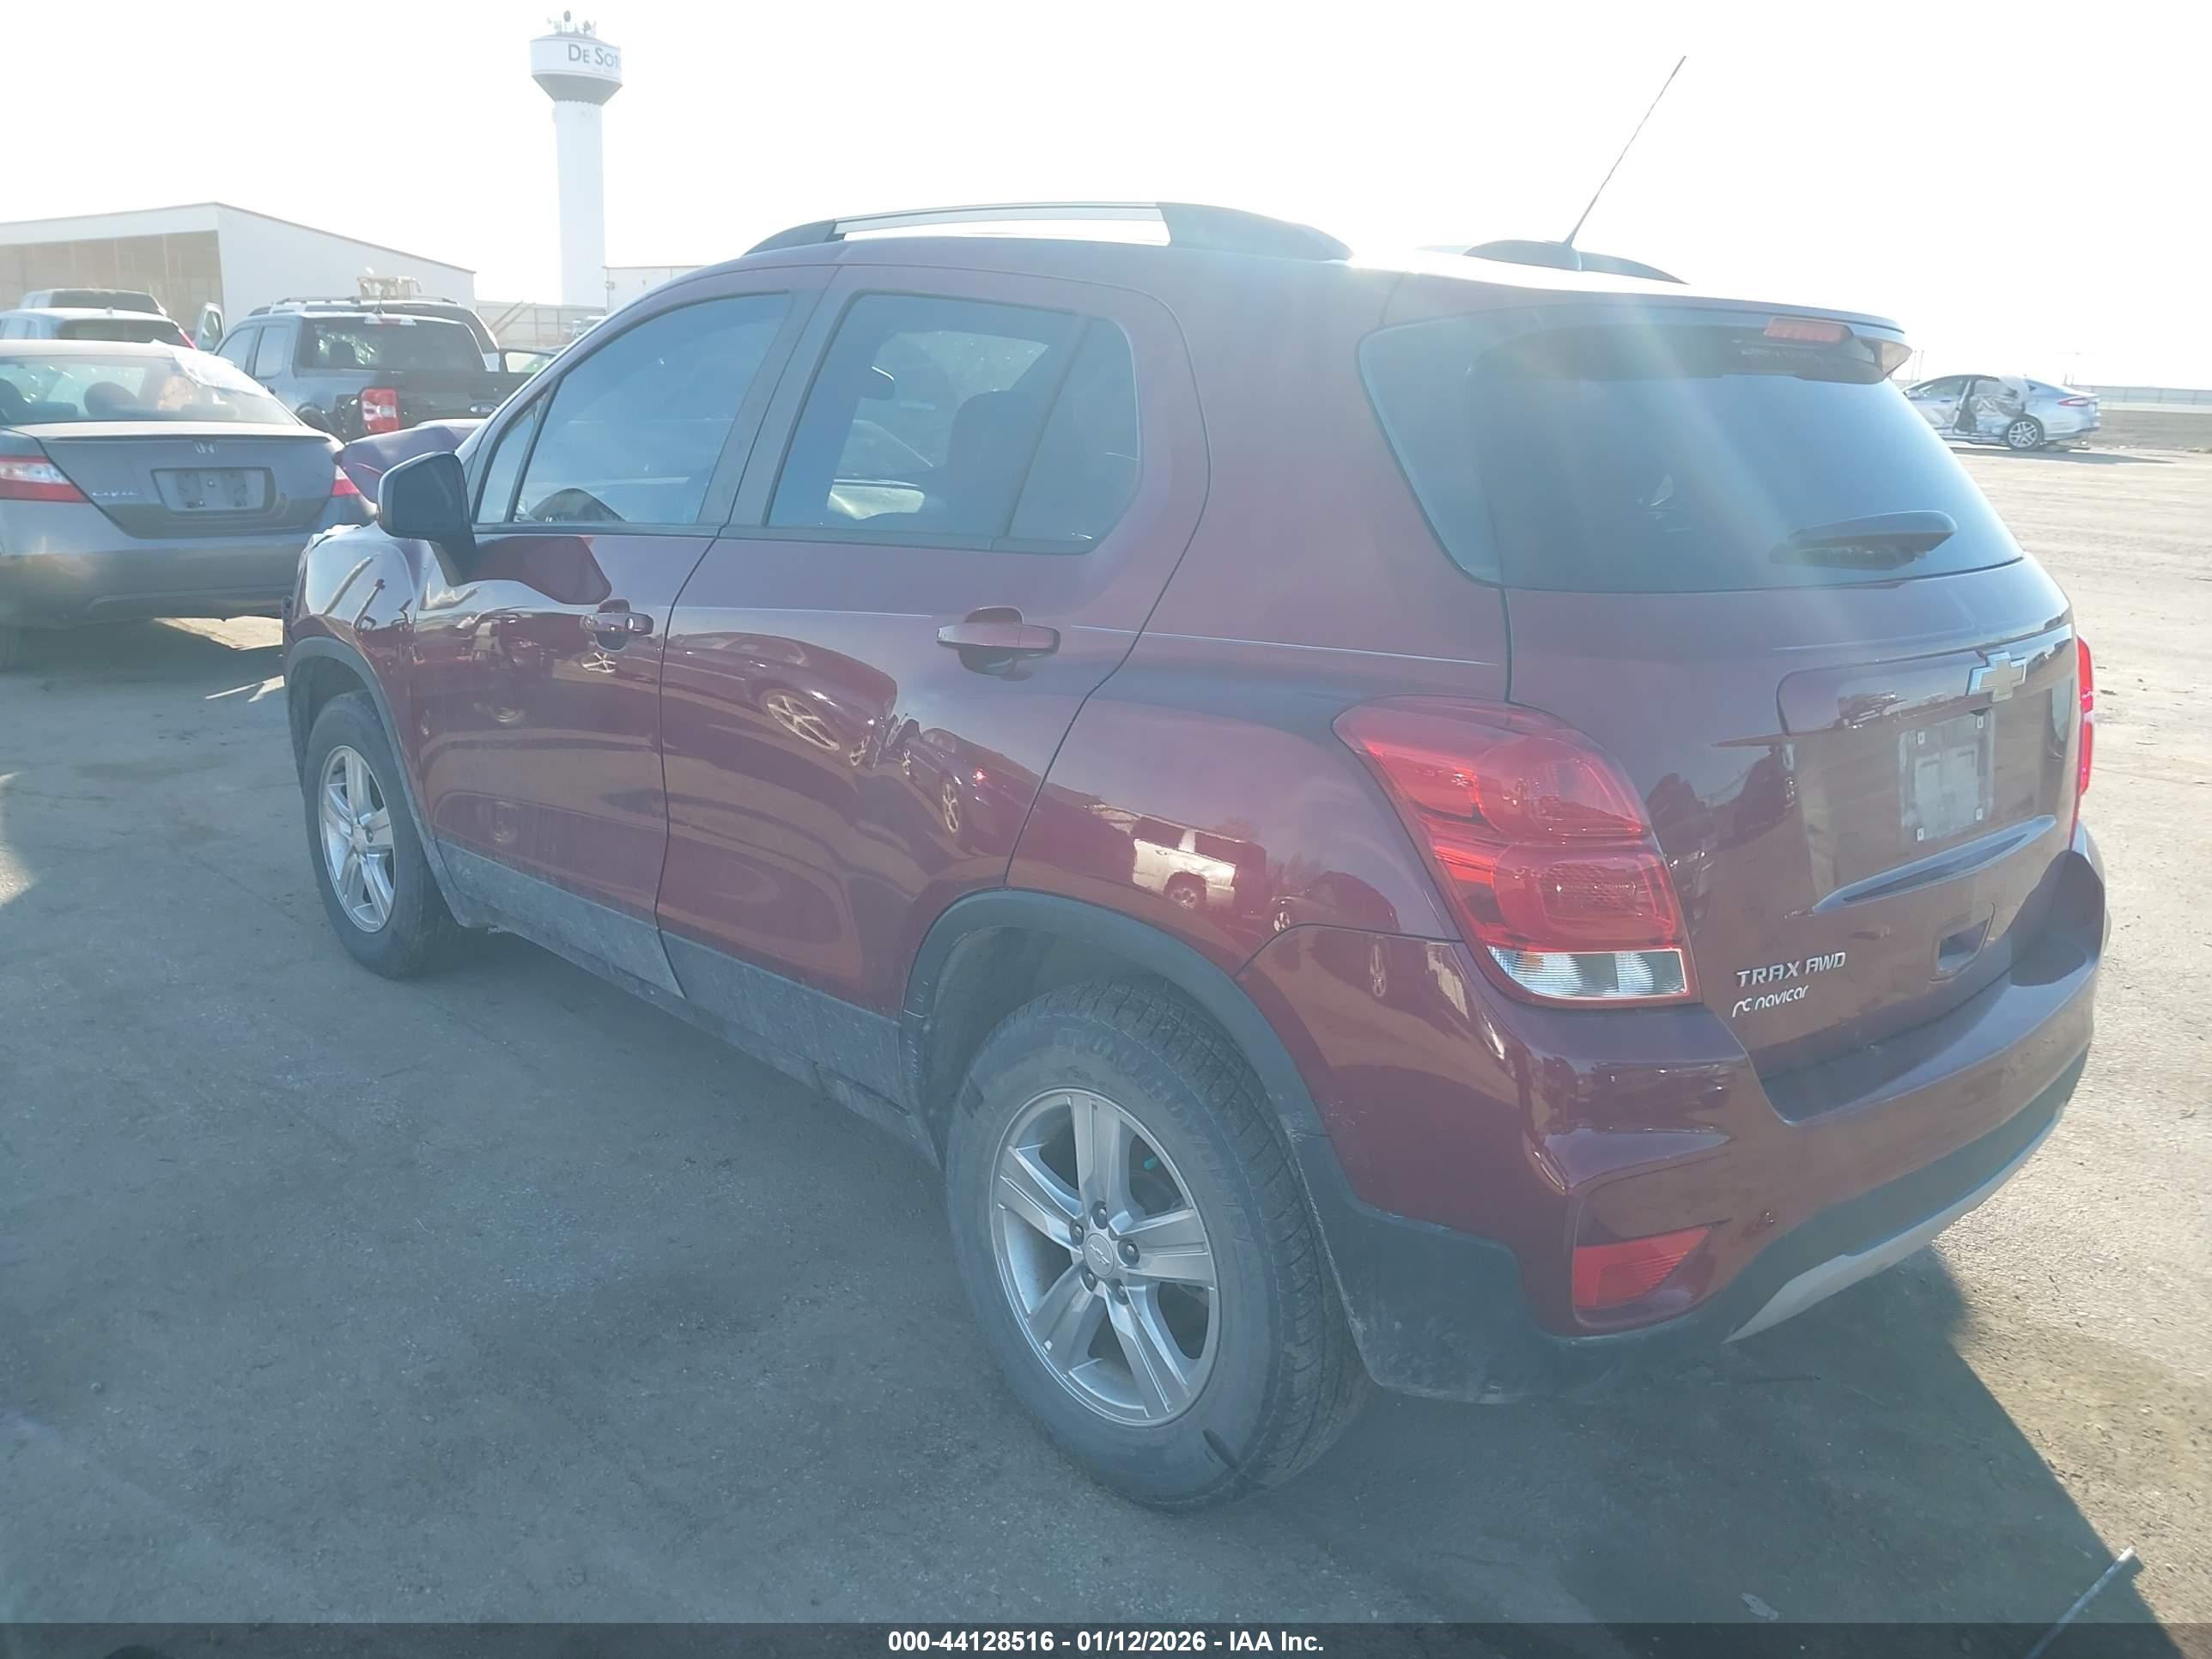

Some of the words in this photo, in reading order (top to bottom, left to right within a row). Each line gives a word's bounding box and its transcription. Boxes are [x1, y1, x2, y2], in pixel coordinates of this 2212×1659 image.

[1735, 960, 1801, 988] TRAX
[1804, 951, 1847, 975] AWD
[1754, 985, 1809, 1011] navicar
